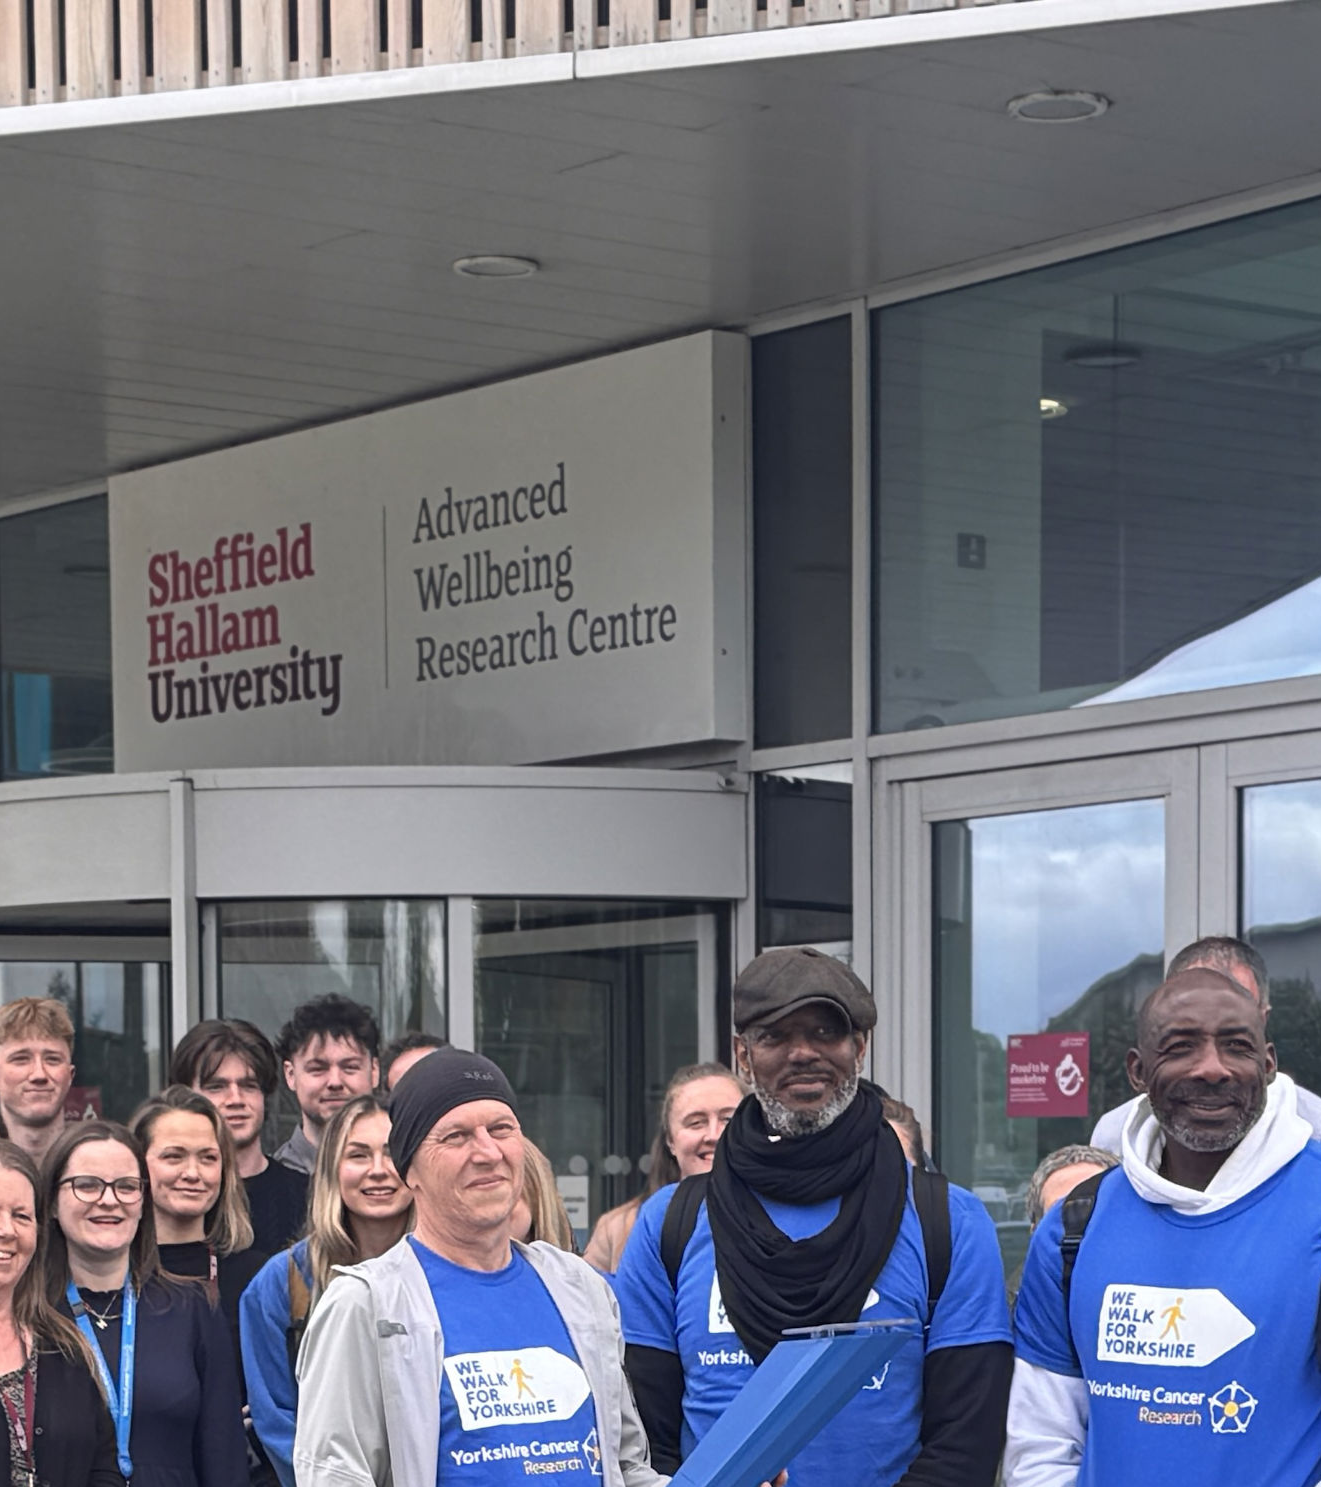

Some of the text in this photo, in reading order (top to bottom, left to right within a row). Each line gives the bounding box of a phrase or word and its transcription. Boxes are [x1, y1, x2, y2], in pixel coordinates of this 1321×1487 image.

[412, 462, 567, 543] Advanced
[148, 523, 315, 608] Sheffield
[413, 545, 574, 612] Wellbeing
[147, 603, 281, 667] Hallam
[416, 602, 677, 683] Research Centre
[148, 646, 342, 724] University
[1111, 1291, 1136, 1306] WE
[1108, 1306, 1155, 1325] WALK
[1106, 1323, 1137, 1339] FOR
[1104, 1338, 1196, 1358] YORKSHIRE
[455, 1360, 482, 1376] WE
[460, 1373, 508, 1390] WALK
[1087, 1379, 1205, 1405] Yorkshire Cancer
[466, 1388, 500, 1405] FOR
[469, 1399, 557, 1421] YORKSHIRE
[1138, 1406, 1202, 1426] Research
[450, 1439, 579, 1466] Yorkshire Cancer
[523, 1456, 584, 1475] Research
